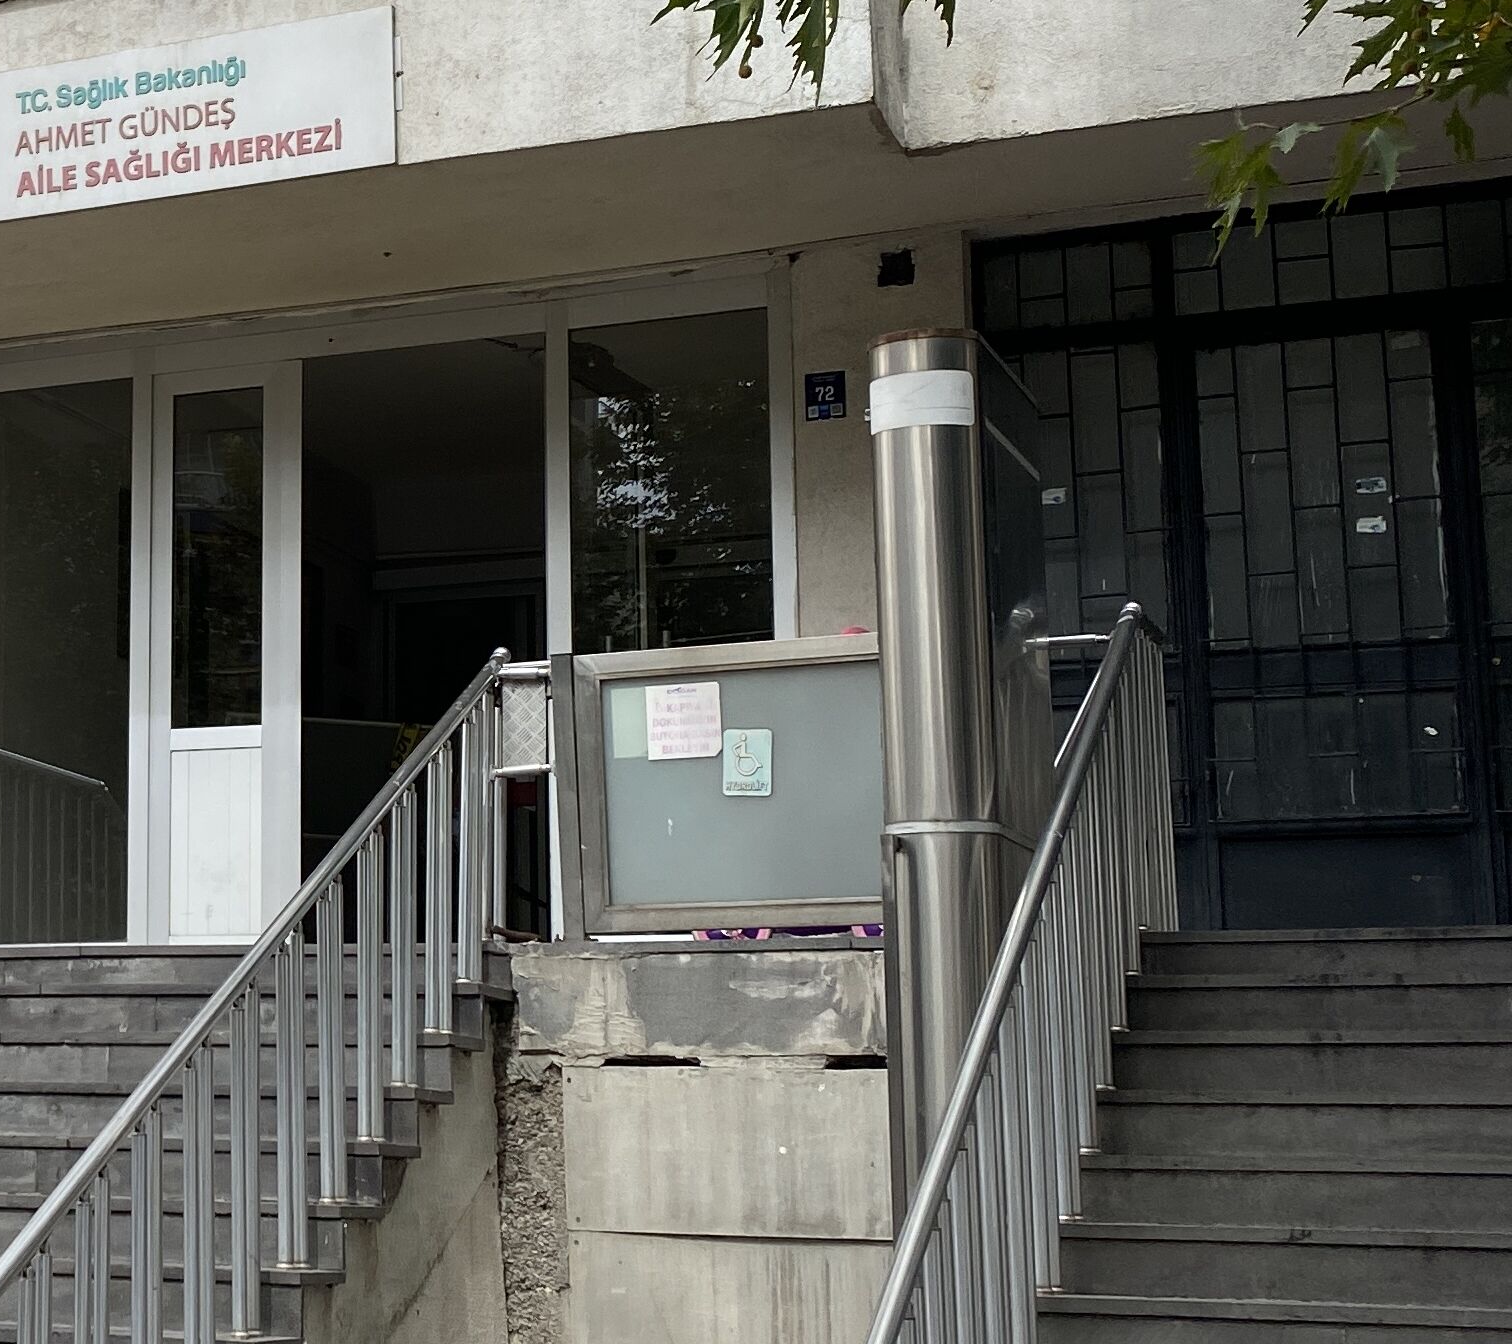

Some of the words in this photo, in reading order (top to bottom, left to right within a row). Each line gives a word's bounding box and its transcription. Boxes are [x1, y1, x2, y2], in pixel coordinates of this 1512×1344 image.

[15, 89, 52, 114] T.C.
[56, 76, 128, 110] Sağlık
[135, 56, 246, 96] Bakanlığı
[15, 117, 112, 157] AHMET
[118, 97, 236, 140] GÜNDEŞ
[16, 162, 77, 198] AİLE
[84, 141, 201, 188] SAĞLIĞI
[209, 117, 342, 170] MERKEZİ
[815, 385, 835, 402] 72
